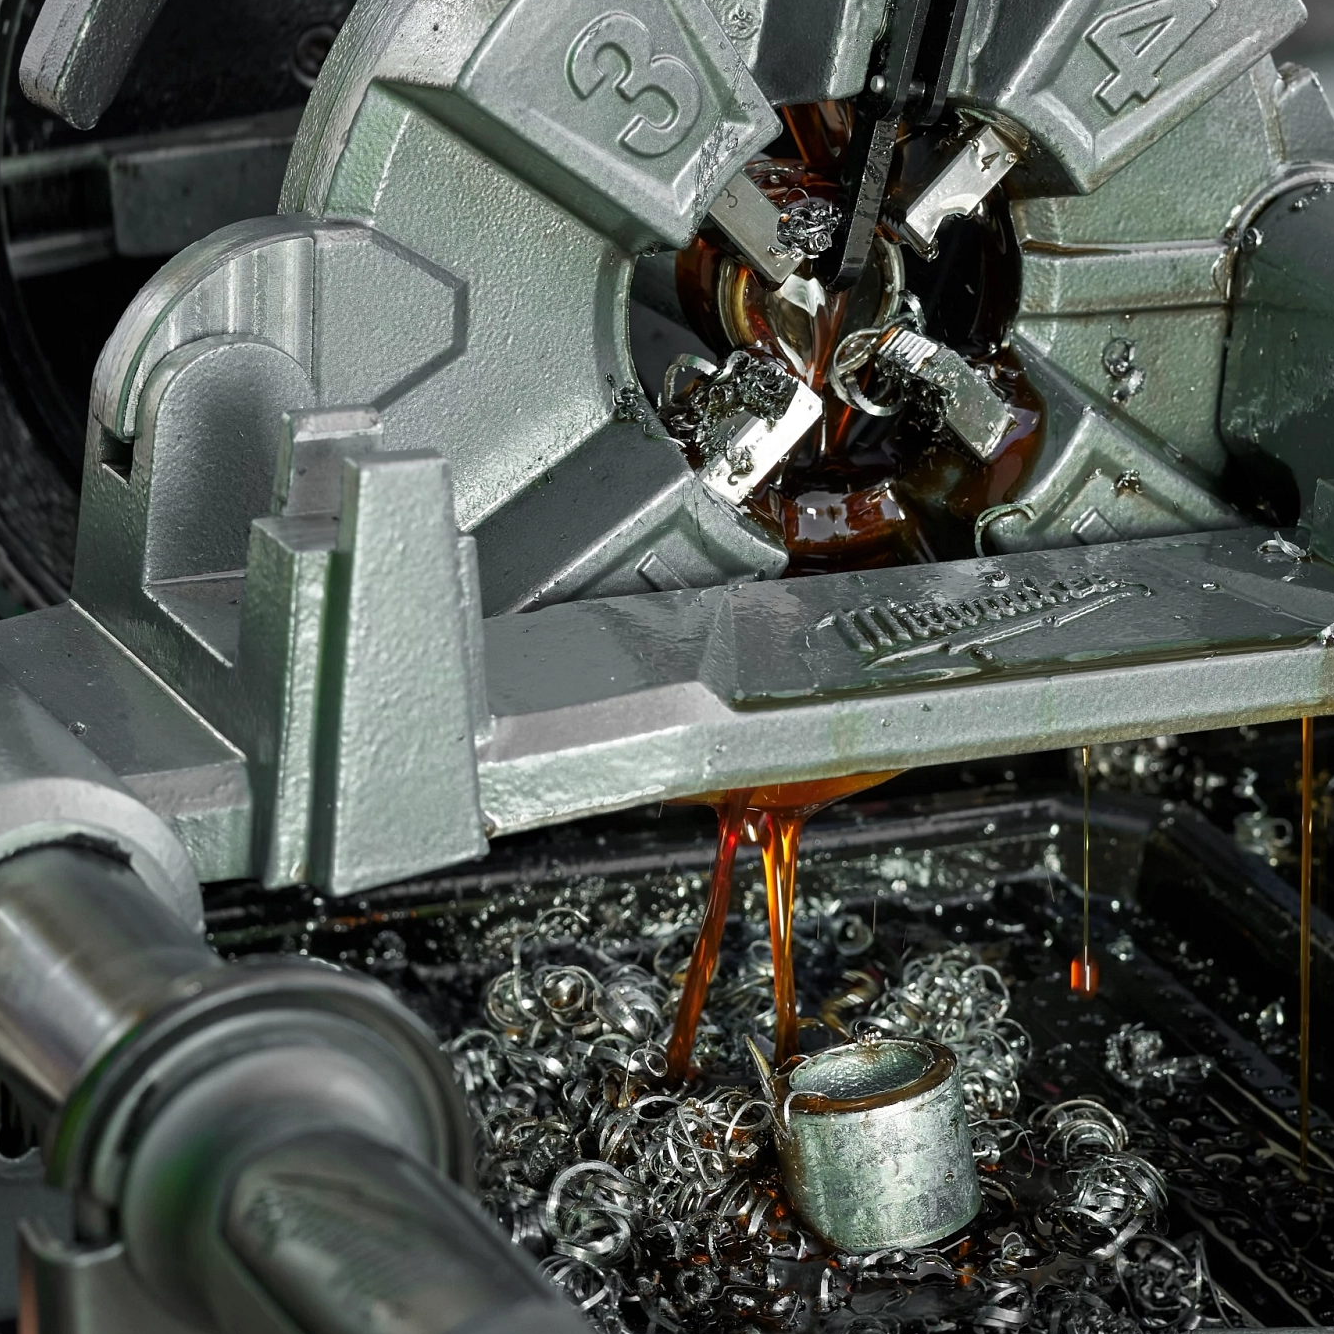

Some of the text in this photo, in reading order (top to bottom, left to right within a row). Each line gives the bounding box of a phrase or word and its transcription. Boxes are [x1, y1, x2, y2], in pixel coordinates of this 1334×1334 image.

[564, 10, 702, 159] 3
[981, 151, 1000, 172] 4
[720, 188, 738, 208] 3
